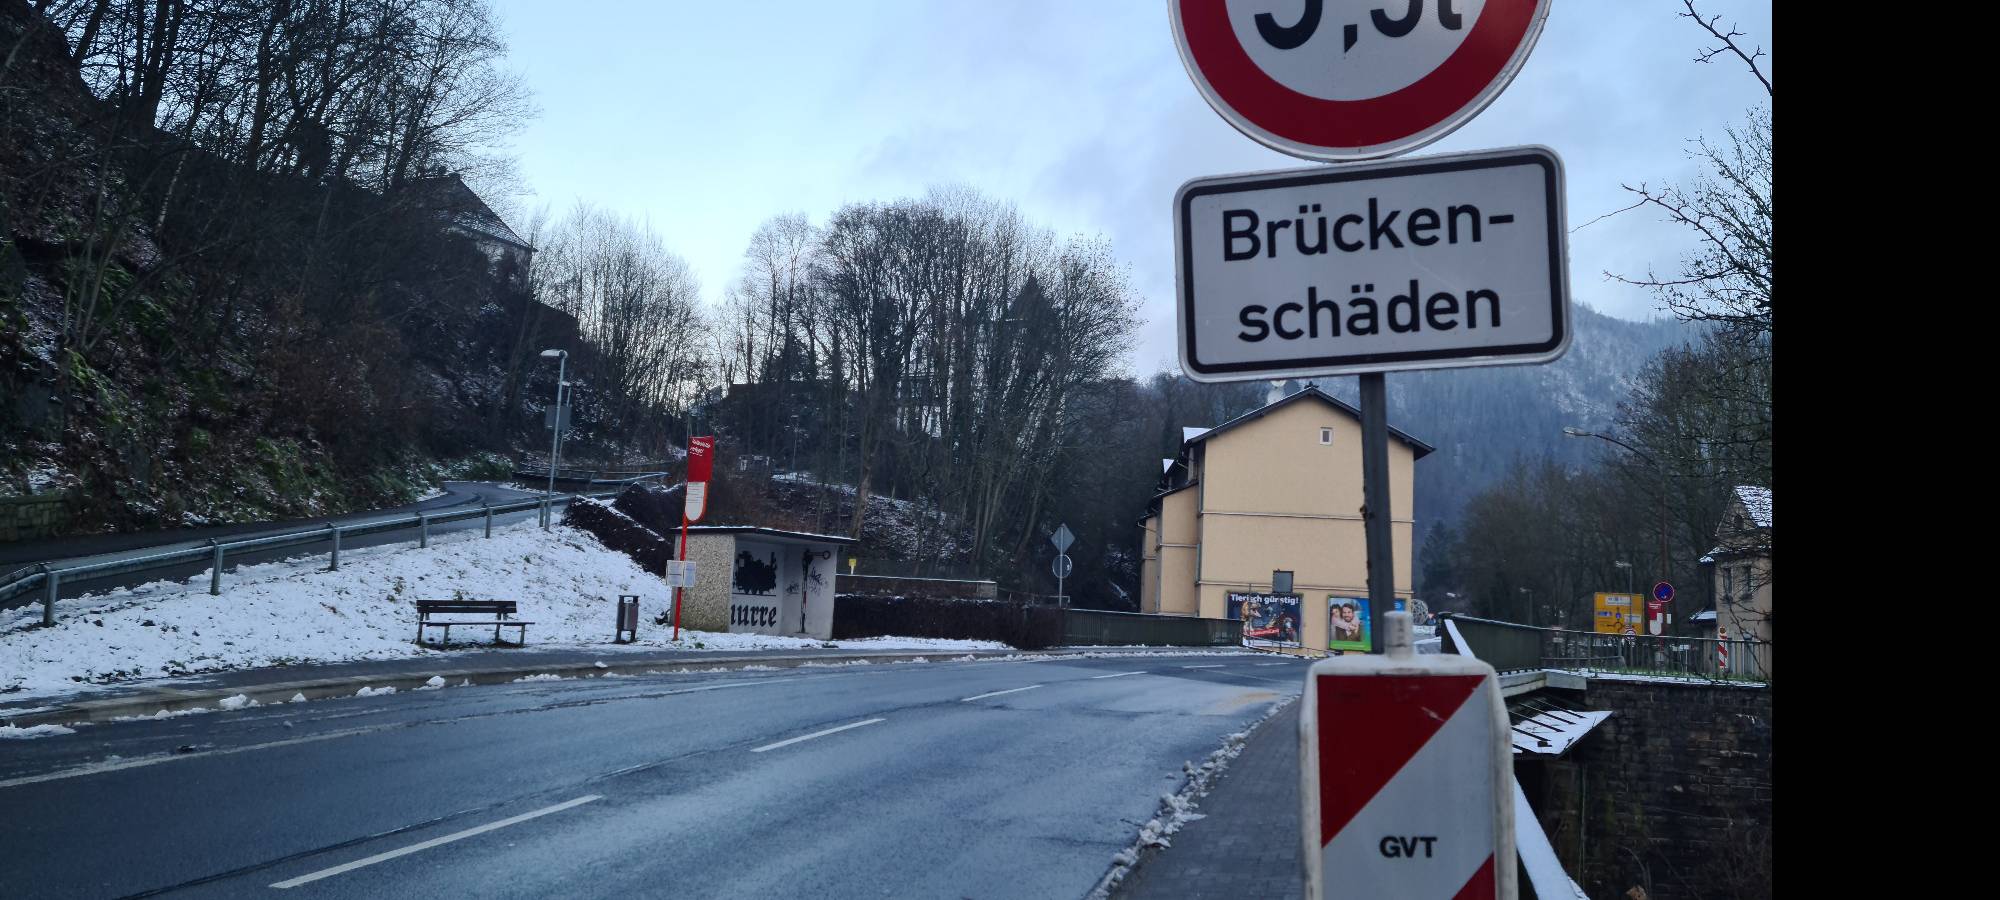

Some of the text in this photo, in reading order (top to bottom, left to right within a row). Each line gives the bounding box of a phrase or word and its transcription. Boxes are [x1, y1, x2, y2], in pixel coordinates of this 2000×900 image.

[1222, 198, 1514, 262] Brücken-
[1238, 280, 1502, 343] schäden
[1379, 836, 1437, 858] GVT
